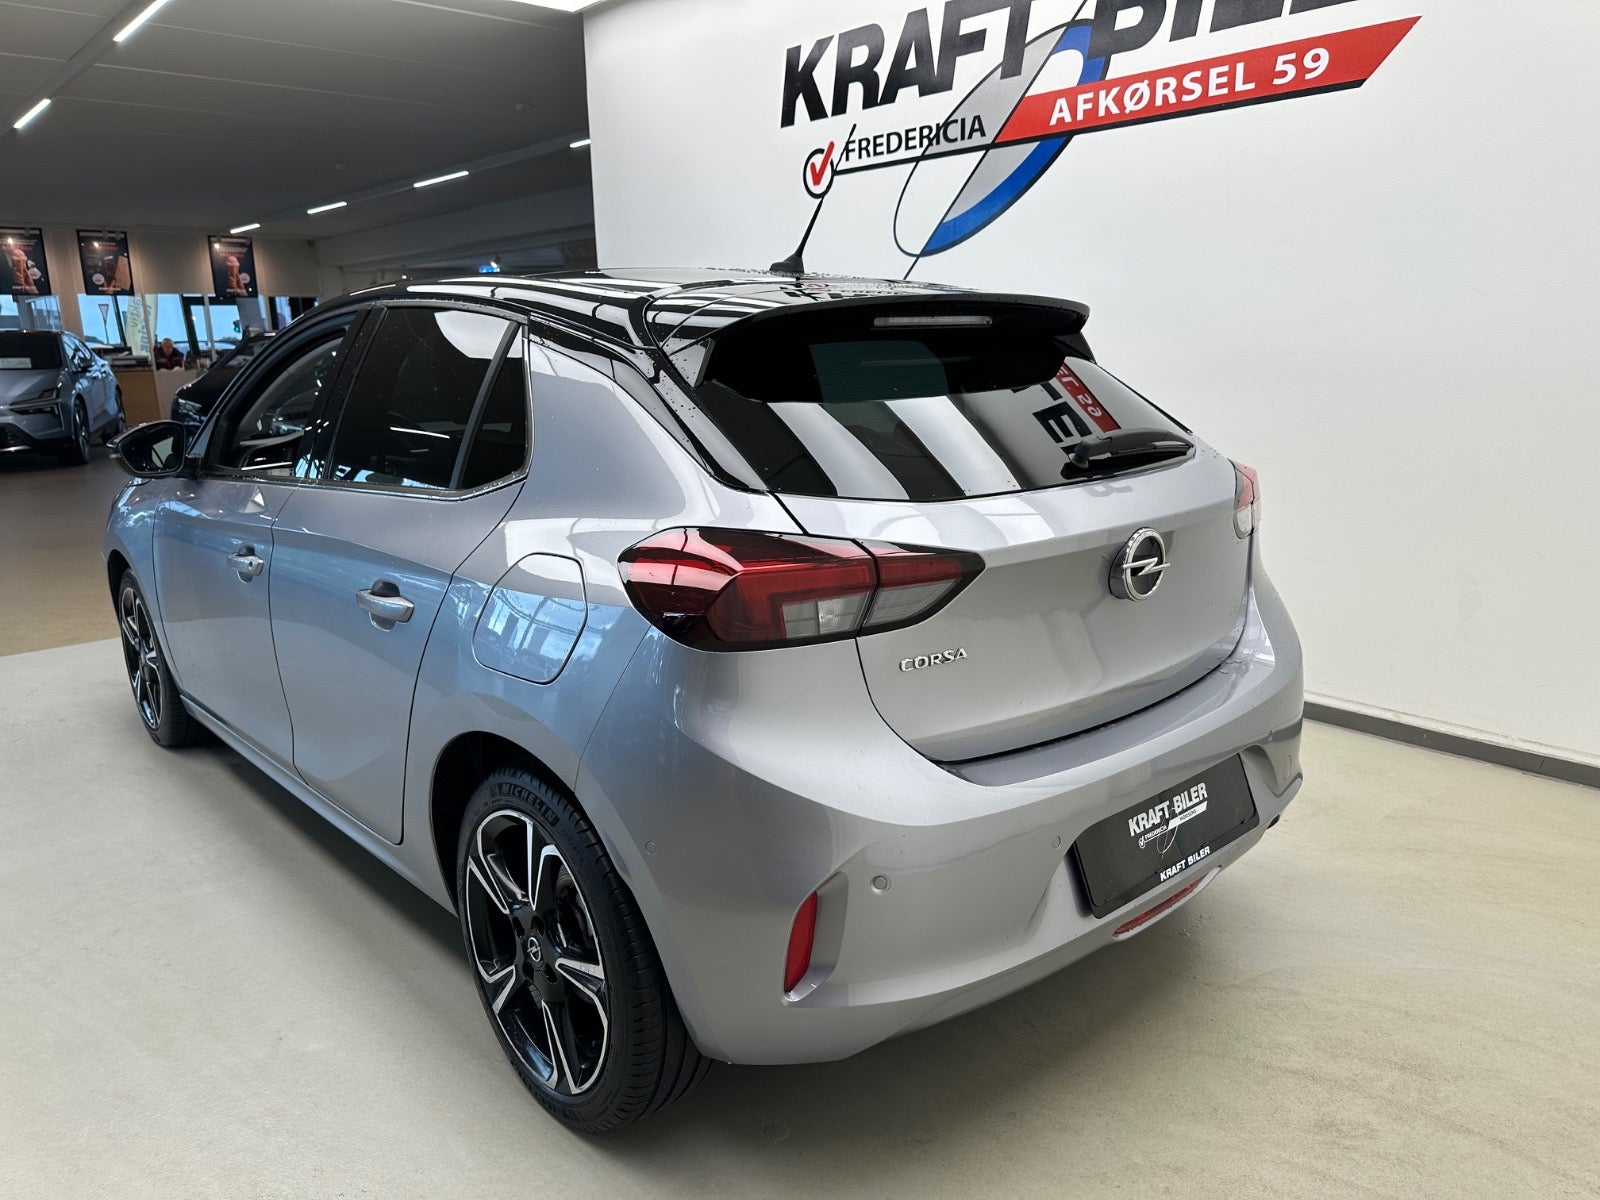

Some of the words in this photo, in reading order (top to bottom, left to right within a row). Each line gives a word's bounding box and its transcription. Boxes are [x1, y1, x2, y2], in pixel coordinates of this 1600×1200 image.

[780, 0, 1035, 128] KRAFT
[1049, 61, 1255, 126] AFKØRSEL
[1272, 47, 1329, 86] 59
[844, 115, 987, 162] FREDERICIA
[899, 647, 968, 672] CORSA
[501, 782, 558, 825] MICHELIN
[1128, 800, 1170, 837] KRAFT
[1172, 782, 1208, 814] BILER
[1160, 859, 1186, 881] KRAFT
[1187, 845, 1211, 866] BILER
